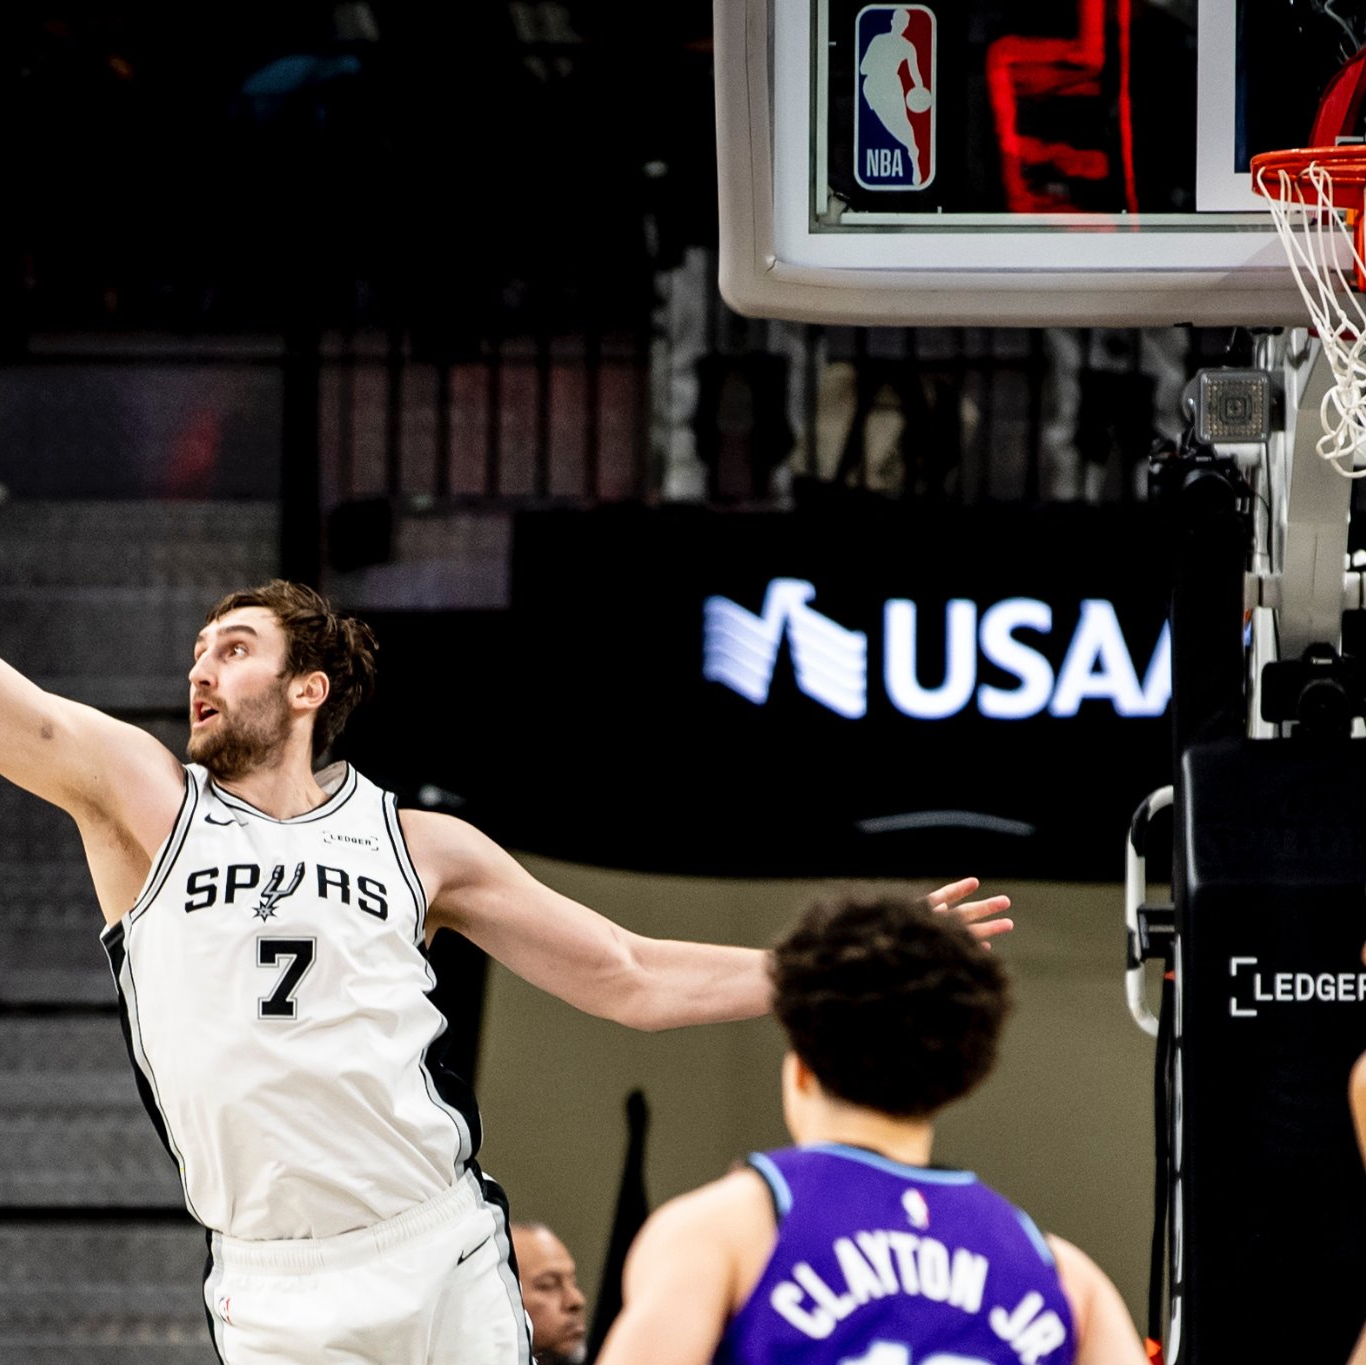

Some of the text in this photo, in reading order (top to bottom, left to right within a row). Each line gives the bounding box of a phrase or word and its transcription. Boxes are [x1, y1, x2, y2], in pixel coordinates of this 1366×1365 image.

[866, 148, 904, 178] NBA
[883, 597, 1175, 721] USA
[330, 834, 371, 846] LEDGER
[183, 861, 389, 922] SPURS
[256, 937, 317, 1020] 7
[770, 1230, 989, 1340] CLAYTON
